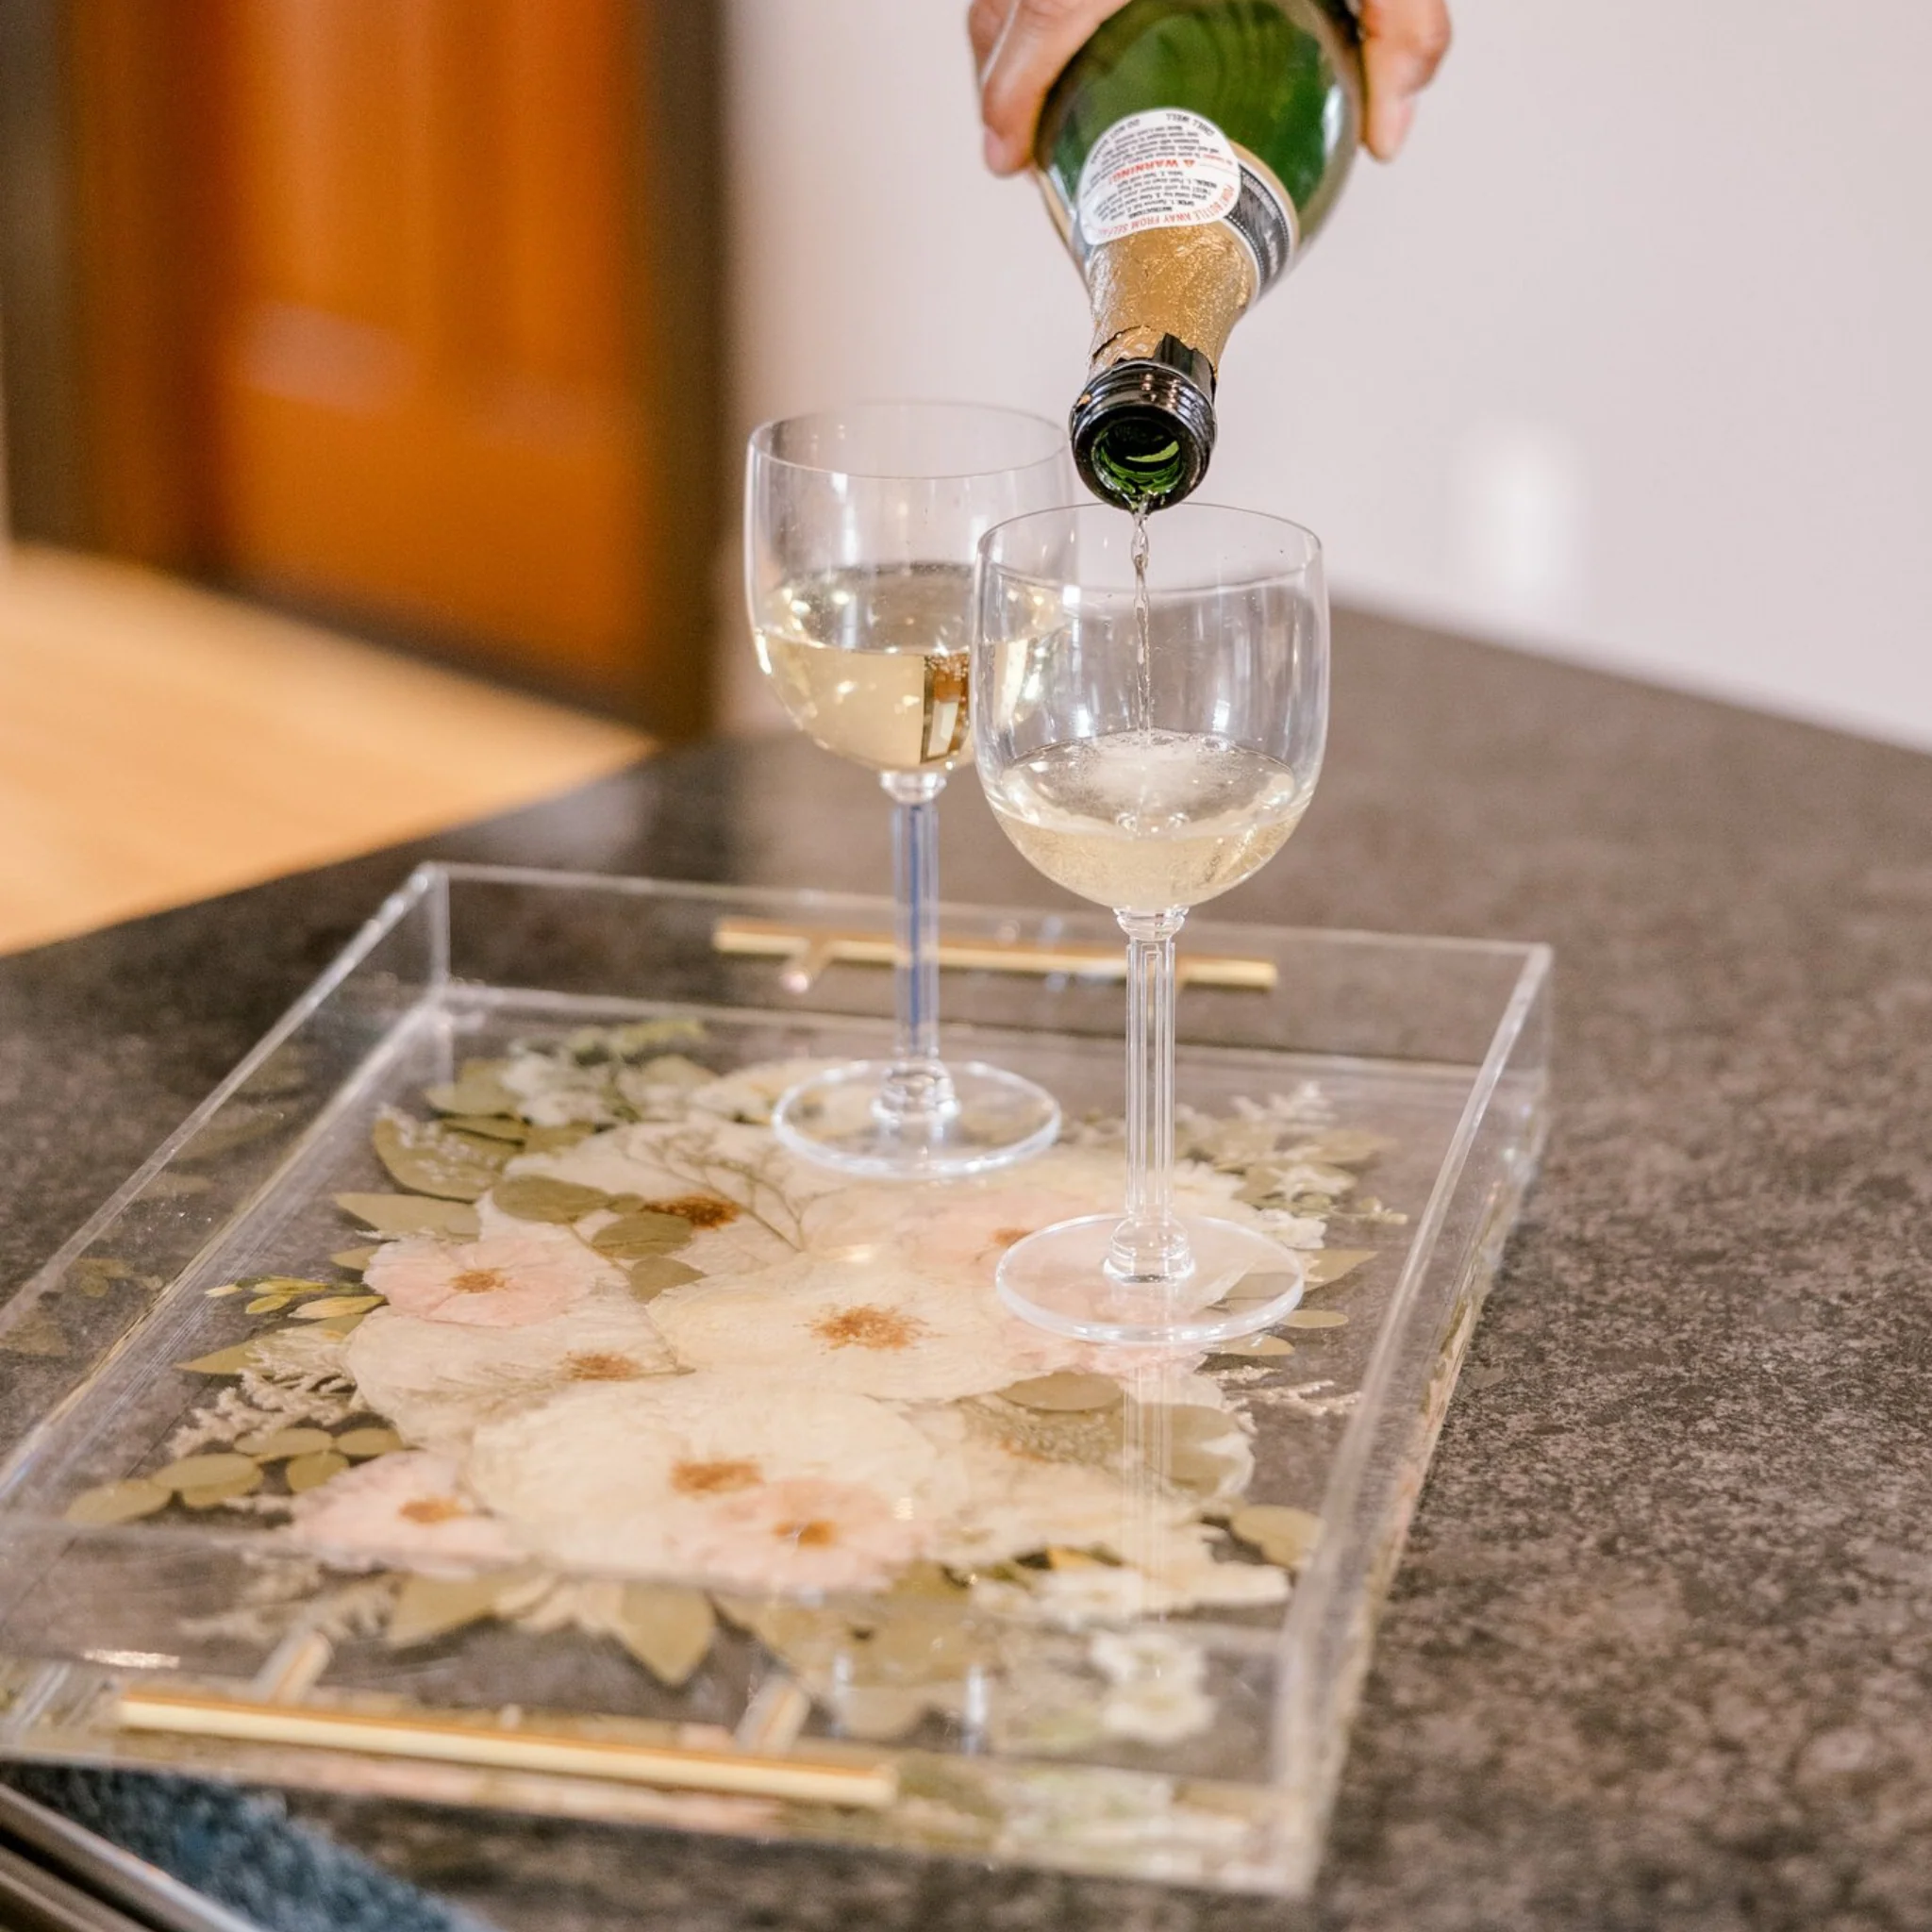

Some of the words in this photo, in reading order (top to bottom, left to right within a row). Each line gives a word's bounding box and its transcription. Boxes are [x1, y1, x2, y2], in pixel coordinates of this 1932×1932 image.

[1166, 113, 1190, 122] WELL
[1131, 215, 1160, 229] FROM
[1163, 212, 1191, 223] AWAY
